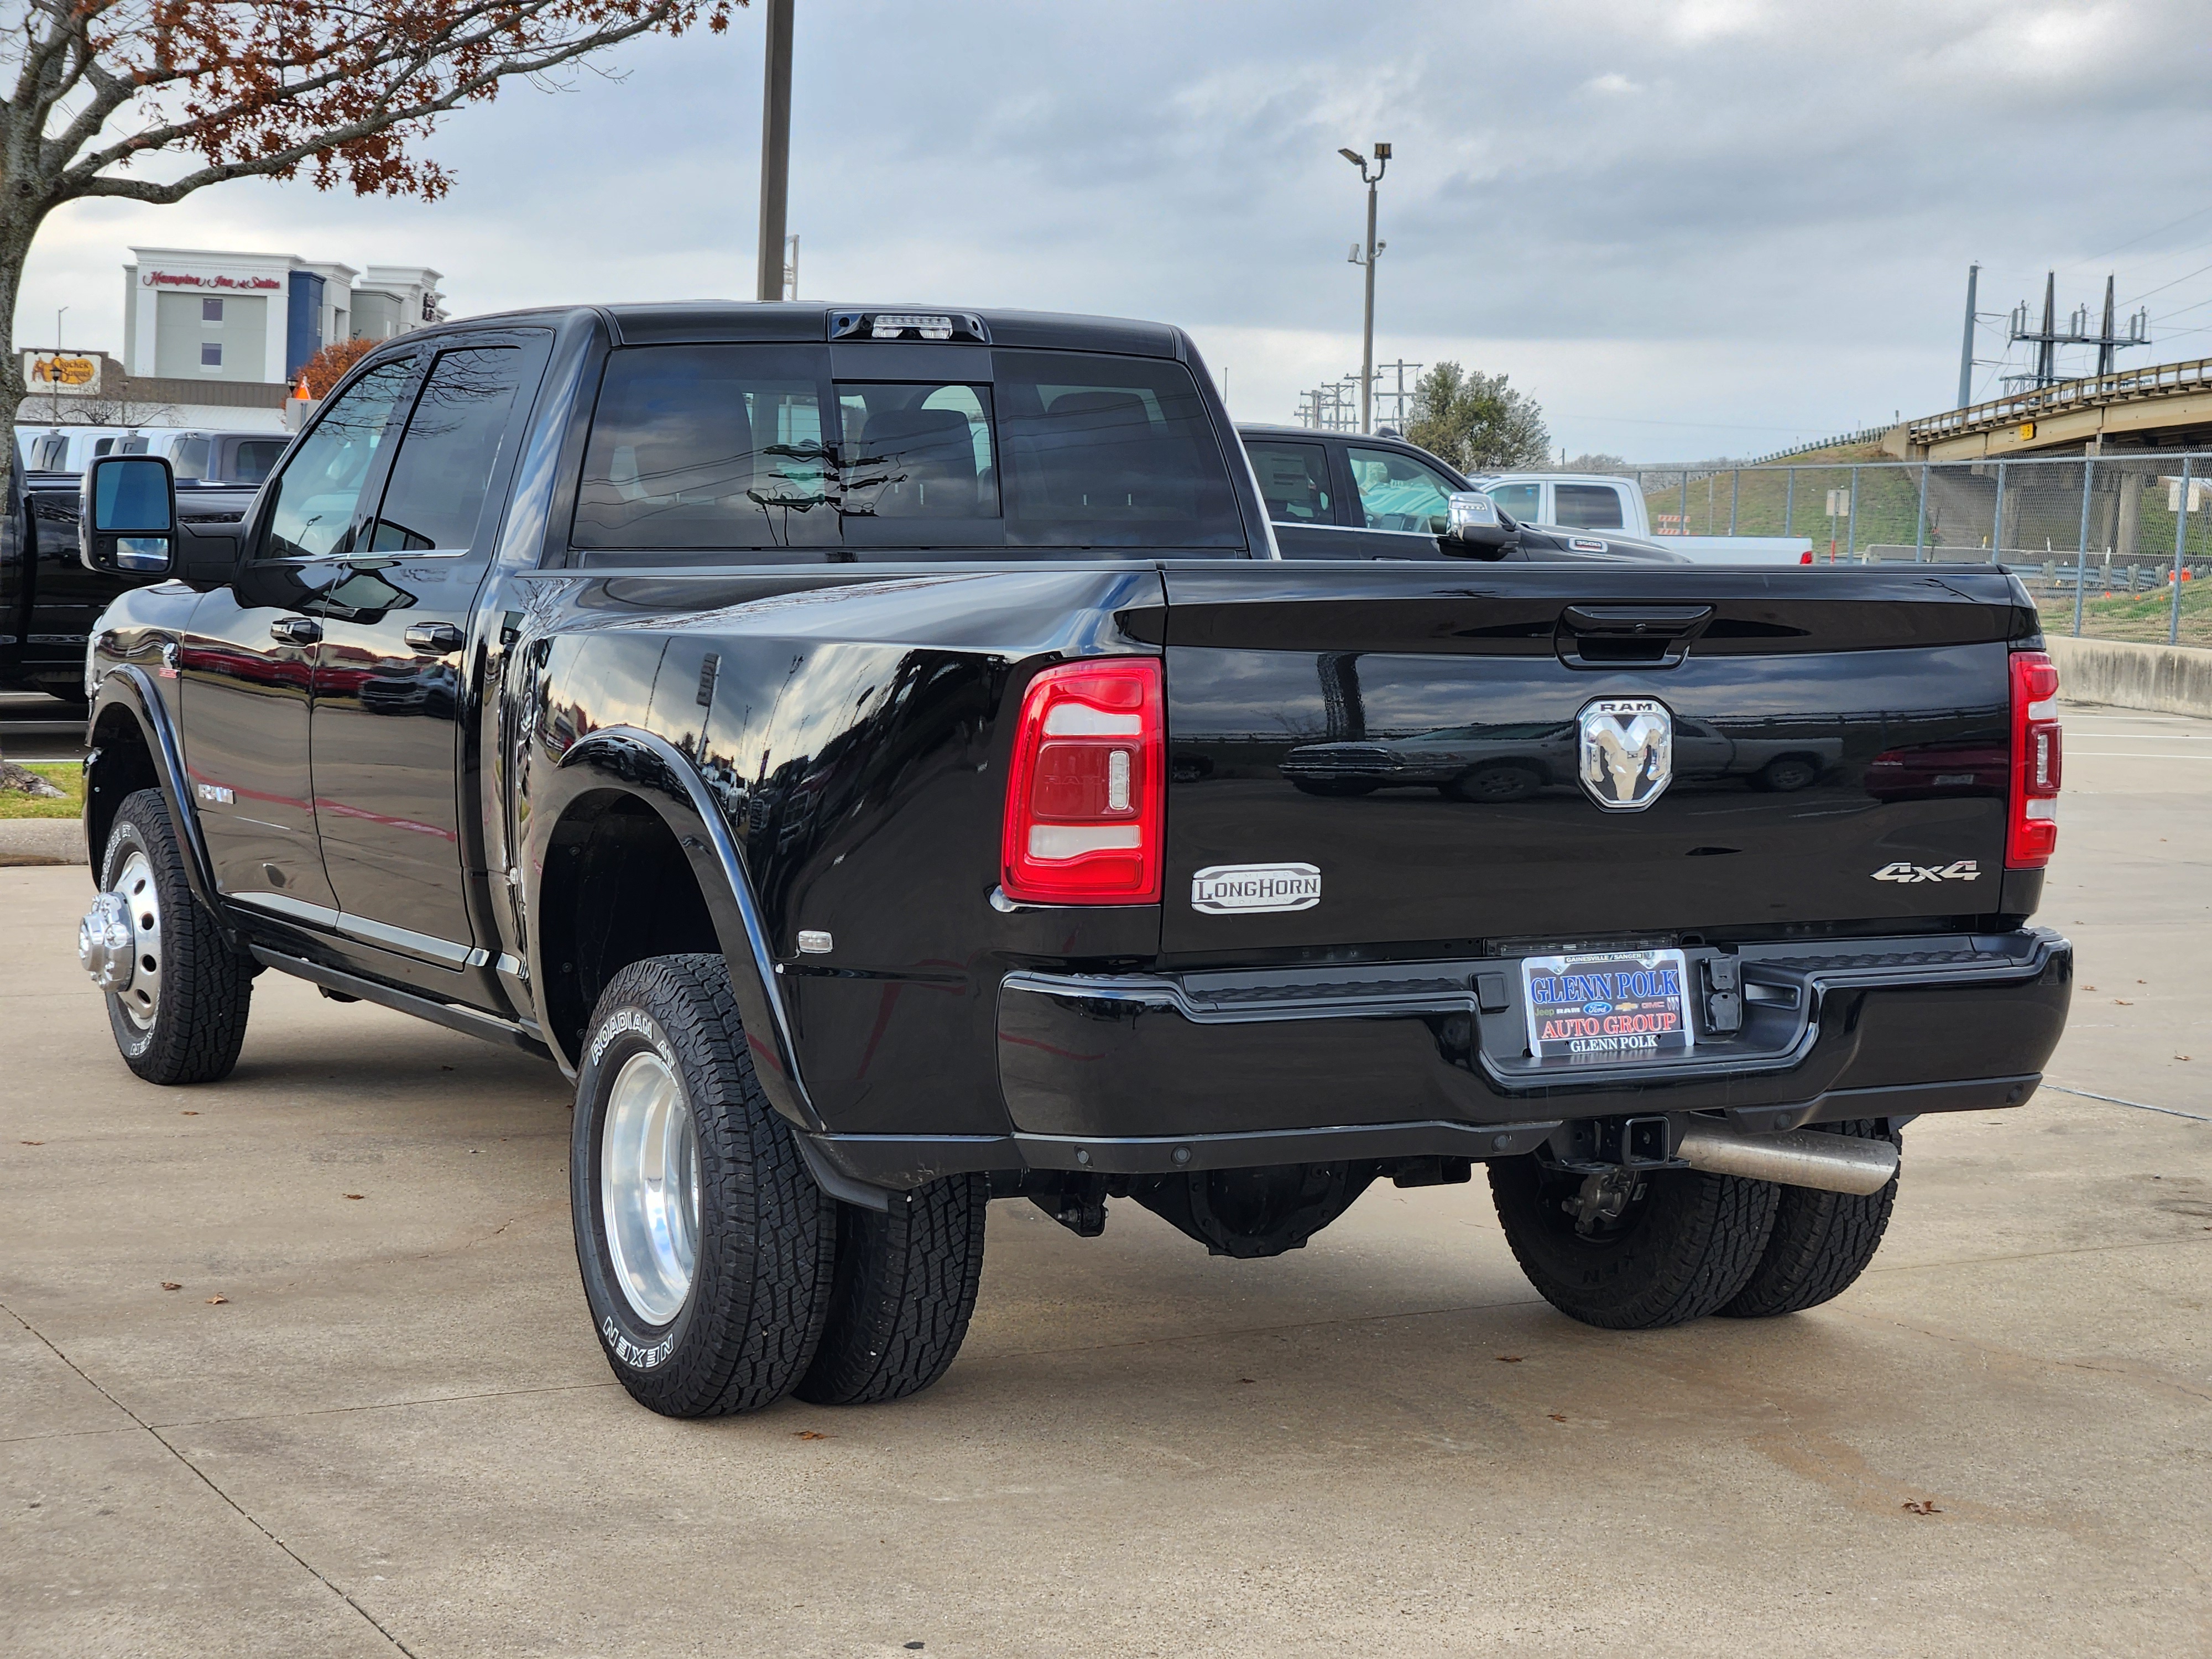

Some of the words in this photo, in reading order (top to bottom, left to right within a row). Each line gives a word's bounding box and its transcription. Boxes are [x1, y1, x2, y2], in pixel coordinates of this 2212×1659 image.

[143, 270, 206, 286] Hampton
[207, 275, 239, 288] Inn
[247, 276, 280, 289] Suites
[1600, 703, 1652, 712] RAM
[1044, 775, 1103, 785] RAM
[198, 784, 235, 805] RAM
[1531, 974, 1612, 1004] GLENN
[1616, 970, 1680, 998] POLK
[1534, 1007, 1556, 1018] Jeep
[1588, 1003, 1607, 1013] Ford
[1641, 1001, 1665, 1009] GMC
[1542, 1016, 1599, 1039] AUTO
[1604, 1013, 1676, 1035] GROUP
[591, 1011, 654, 1067] ROADIAN
[1570, 1039, 1618, 1053] GLENN
[1619, 1034, 1658, 1049] POLK
[603, 1316, 674, 1368] NEXEN
